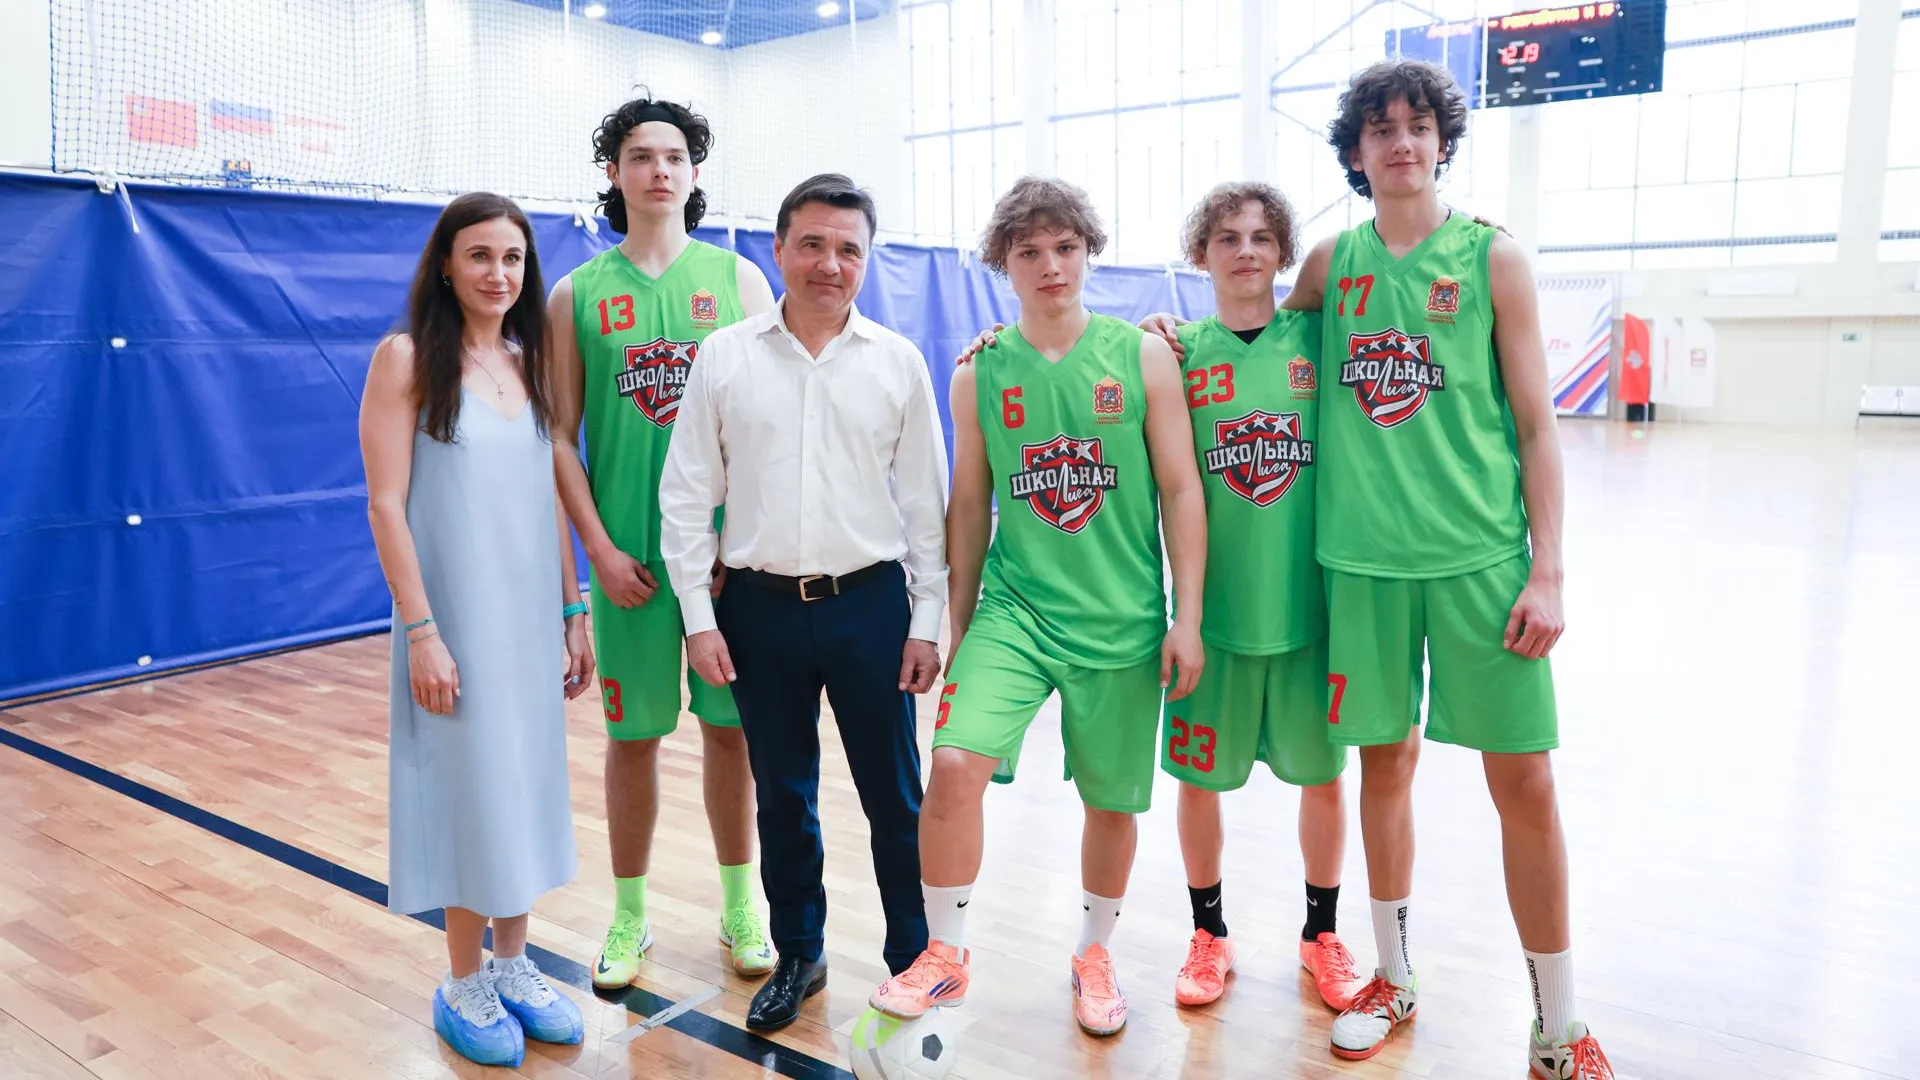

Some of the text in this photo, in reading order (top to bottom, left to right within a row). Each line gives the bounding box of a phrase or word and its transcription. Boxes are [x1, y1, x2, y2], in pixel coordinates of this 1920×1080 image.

[598, 293, 636, 336] 13
[617, 363, 687, 394] ШКОЛЬН
[1186, 363, 1235, 409] 23
[1341, 355, 1443, 387] ШКОЛЬНАЯ
[1002, 386, 1025, 429] 6
[1205, 437, 1312, 471] ШКОЛЬНАЯ
[1011, 462, 1116, 497] ШКОЛЬНАЯ
[600, 675, 624, 723] 3
[1327, 673, 1347, 724] 7
[1168, 715, 1217, 773] 23
